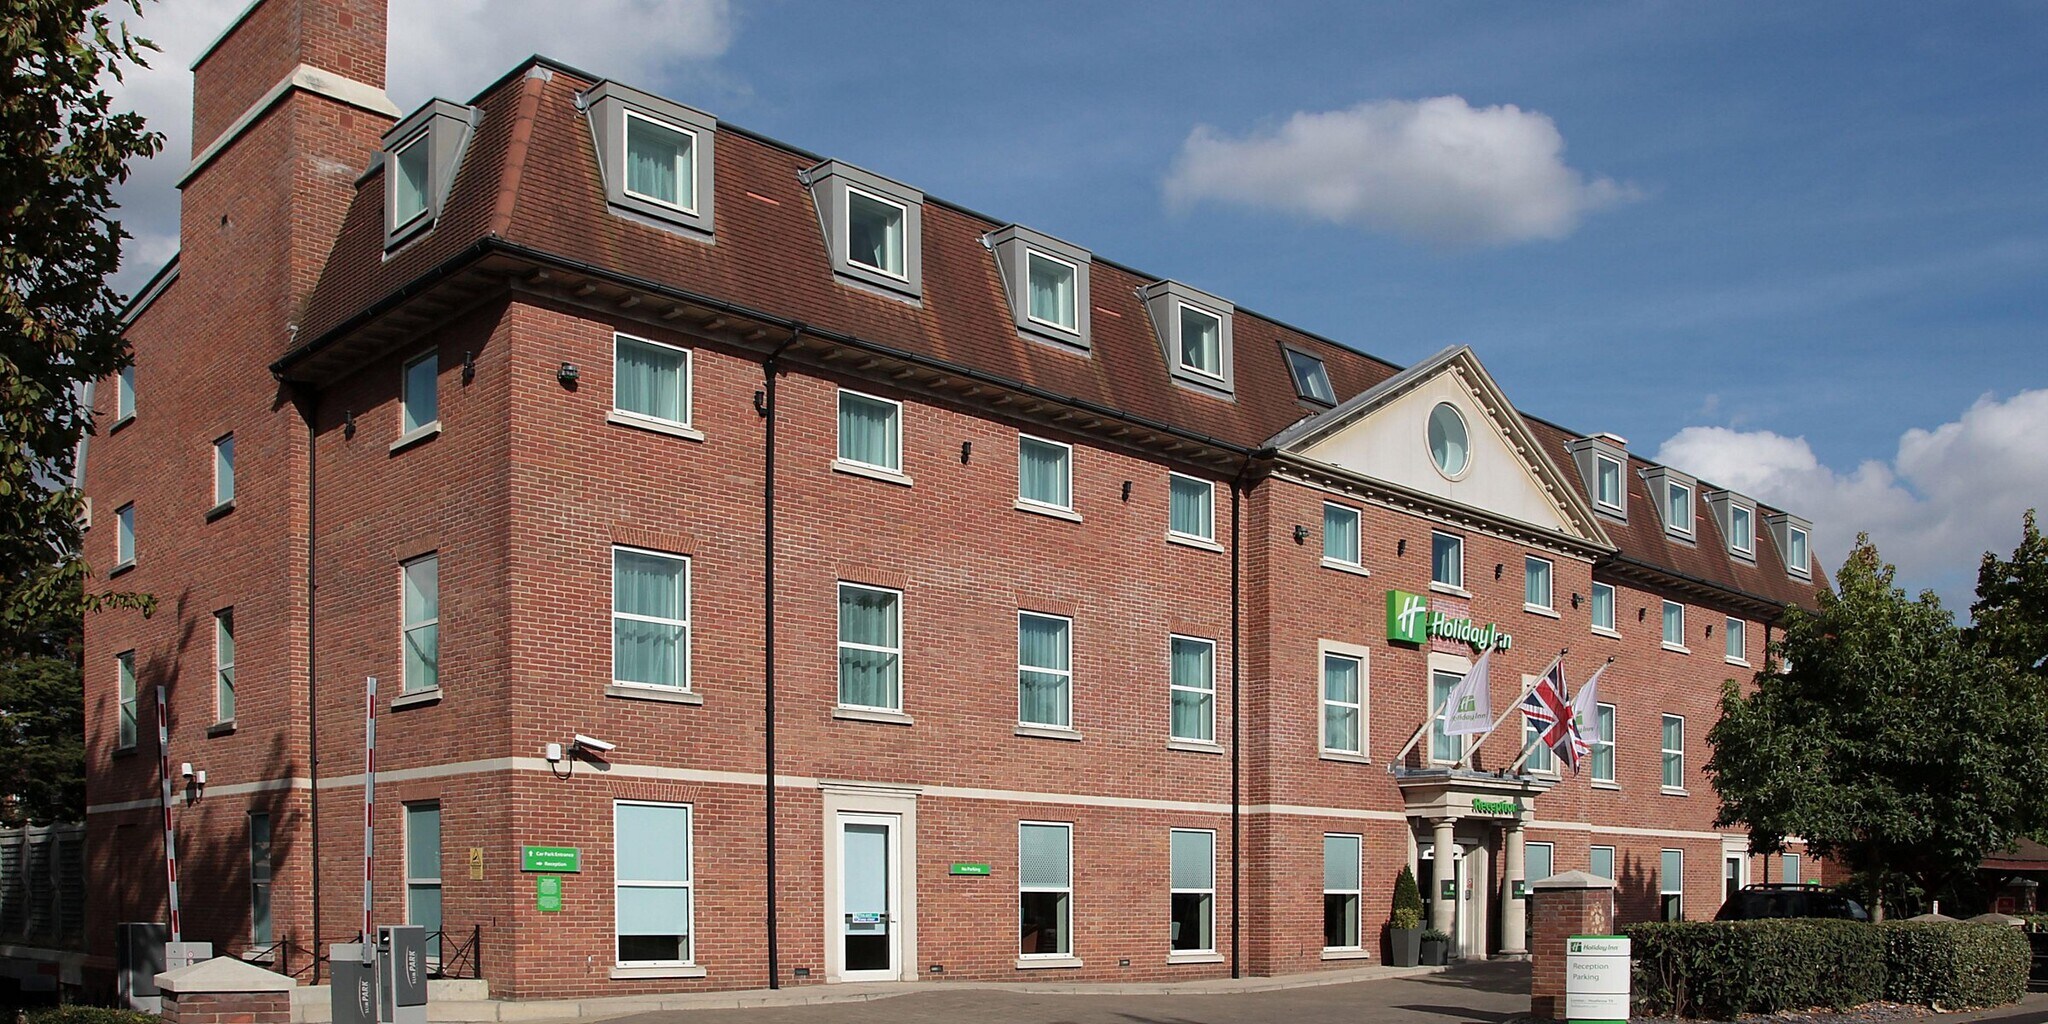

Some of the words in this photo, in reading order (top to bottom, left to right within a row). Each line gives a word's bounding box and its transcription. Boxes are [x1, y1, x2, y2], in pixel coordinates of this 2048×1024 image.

[1432, 612, 1489, 649] Holiday
[1490, 623, 1512, 649] Inn
[1473, 799, 1518, 815] Reception
[409, 950, 417, 972] PARK
[1573, 974, 1600, 982] Parking
[361, 981, 369, 1002] PARK
